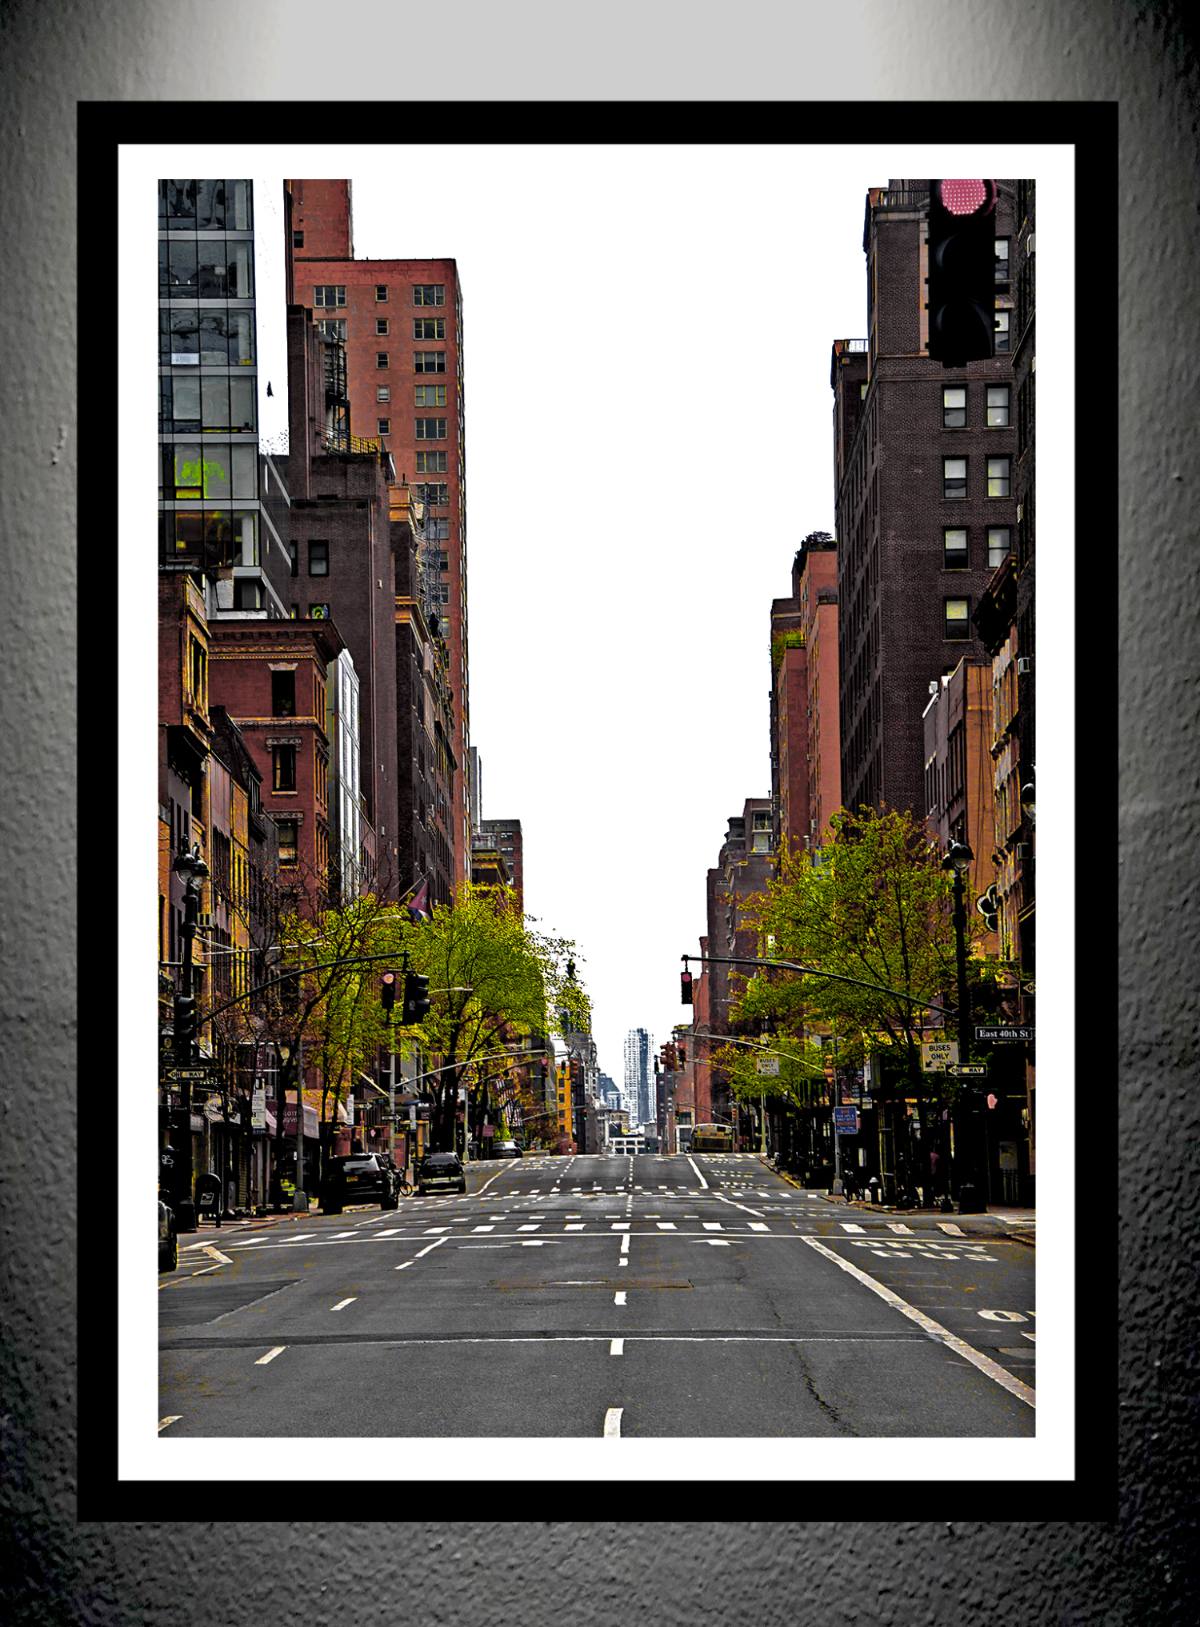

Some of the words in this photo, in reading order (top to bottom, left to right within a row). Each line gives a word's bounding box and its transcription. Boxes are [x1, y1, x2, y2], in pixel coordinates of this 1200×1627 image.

[980, 1030, 997, 1038] East
[999, 1030, 1018, 1038] 40th
[1020, 1030, 1029, 1038] St
